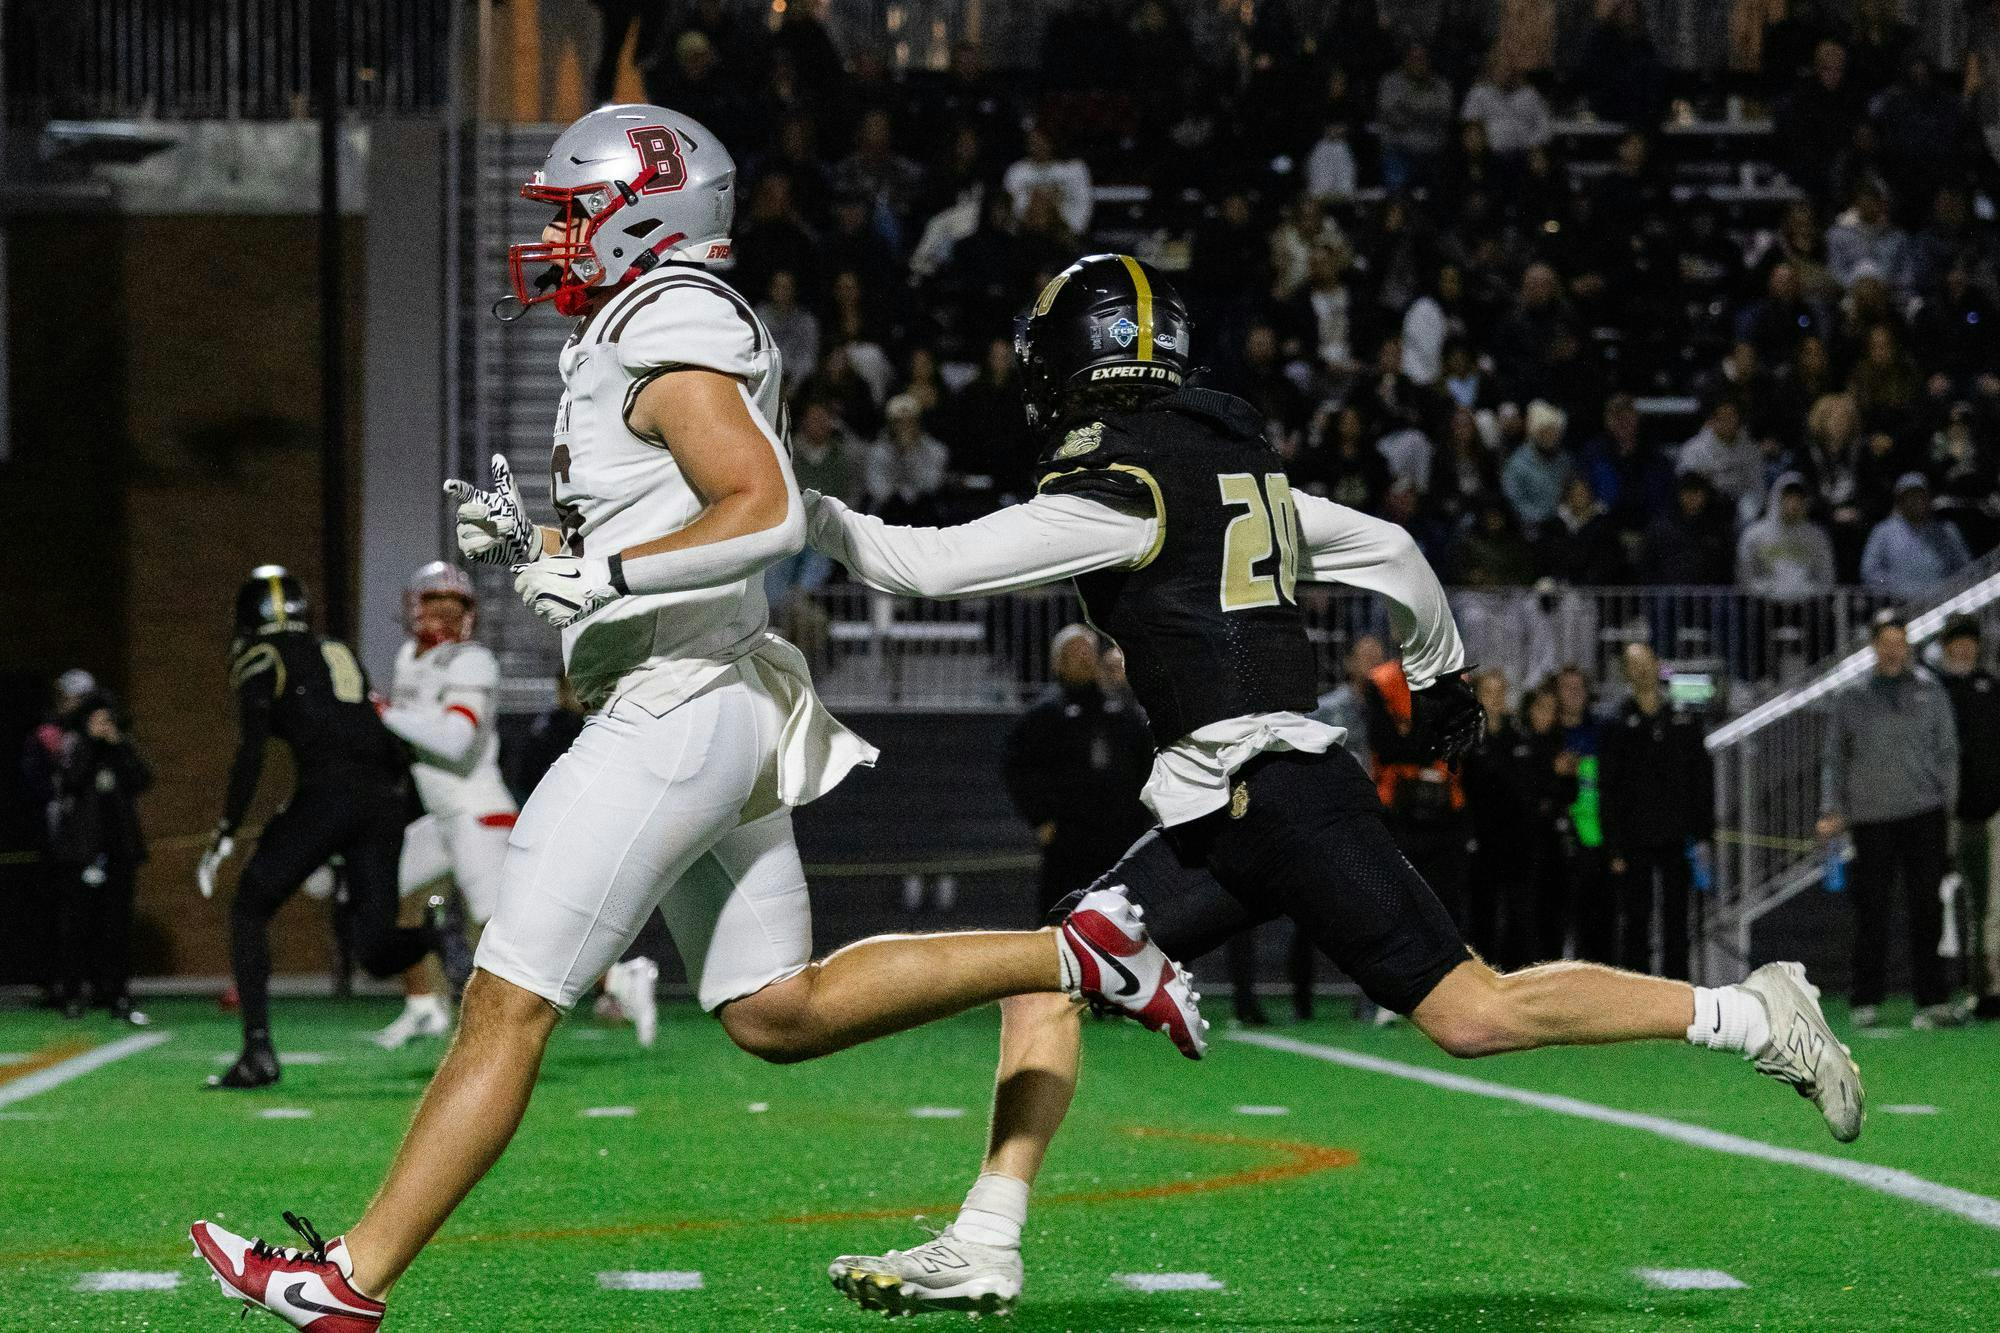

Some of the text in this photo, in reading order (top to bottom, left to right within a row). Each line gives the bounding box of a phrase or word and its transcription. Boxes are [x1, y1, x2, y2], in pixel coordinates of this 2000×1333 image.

[625, 125, 688, 196] B
[1091, 366, 1147, 381] EXPECT
[1149, 367, 1166, 379] TO
[1217, 472, 1298, 612] 20
